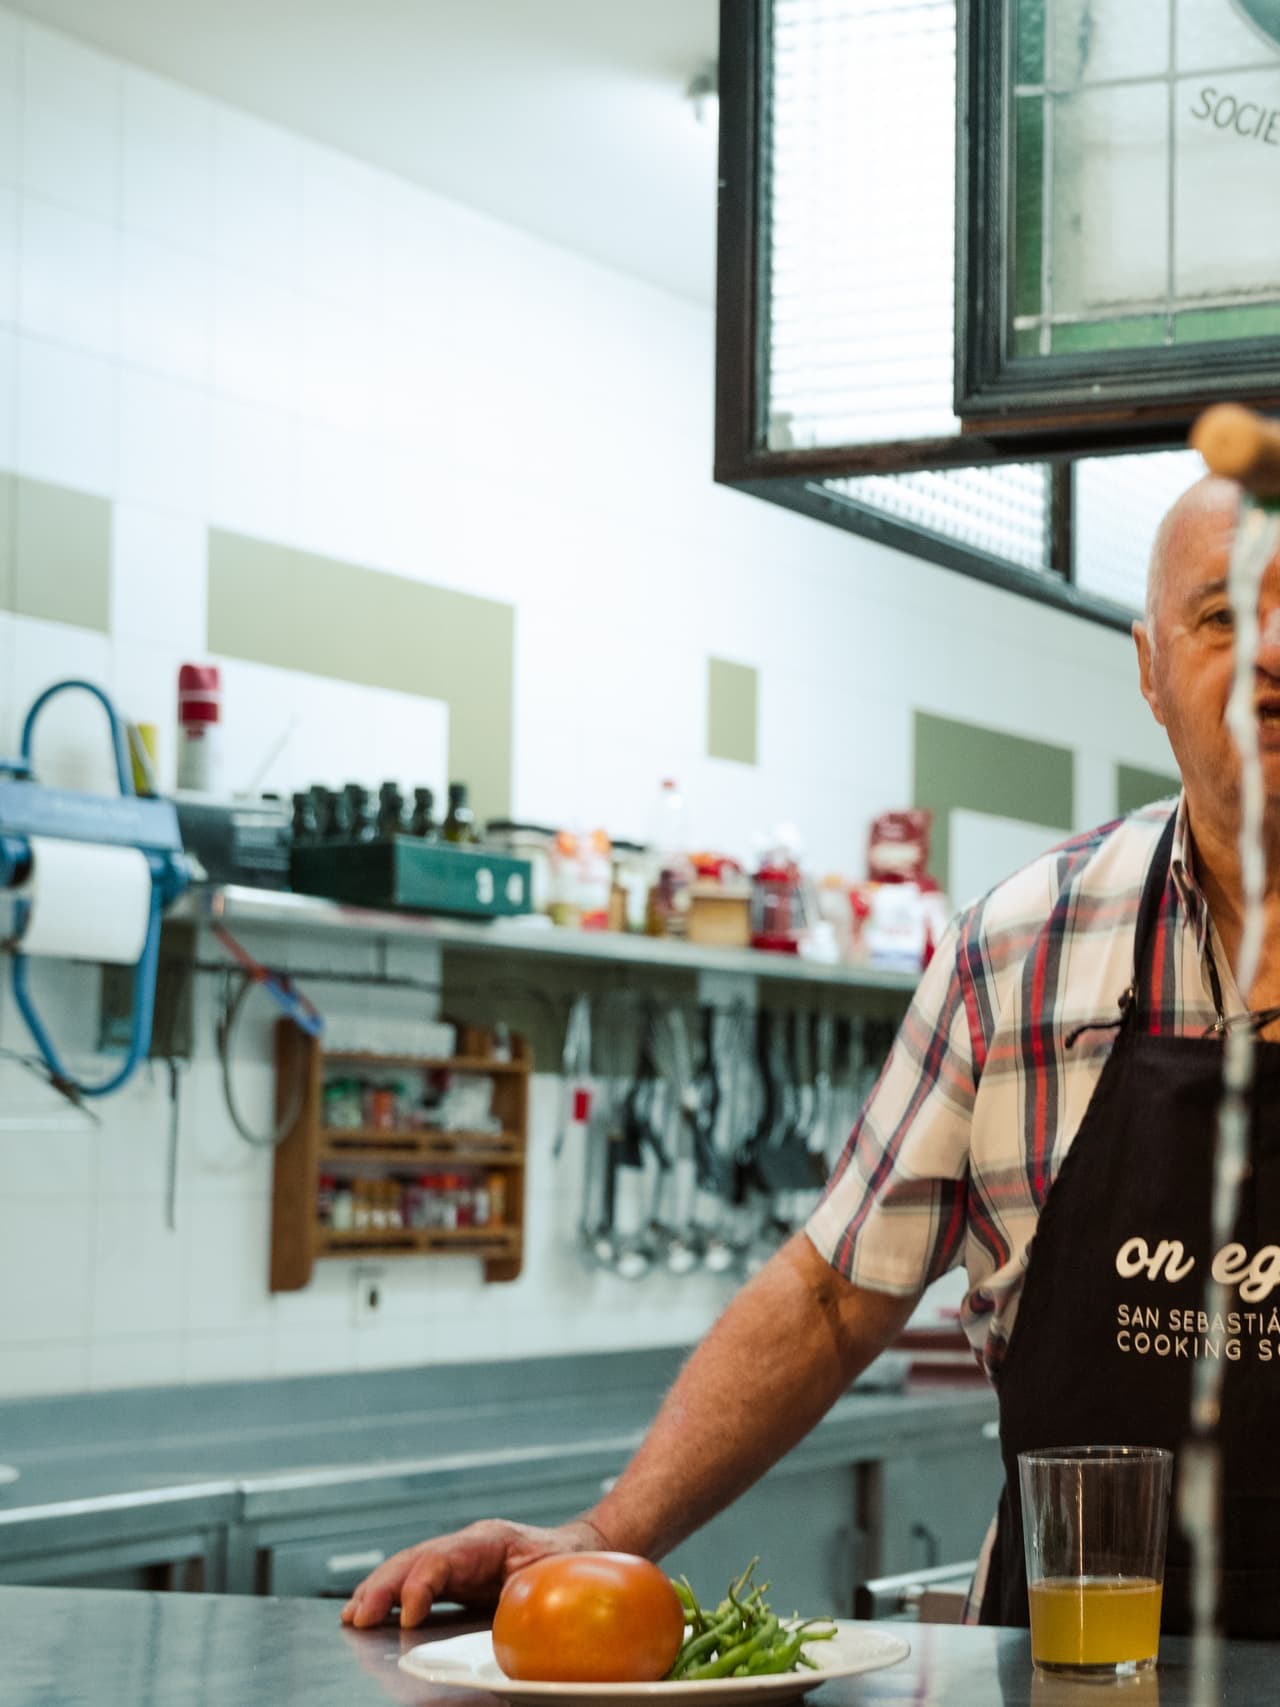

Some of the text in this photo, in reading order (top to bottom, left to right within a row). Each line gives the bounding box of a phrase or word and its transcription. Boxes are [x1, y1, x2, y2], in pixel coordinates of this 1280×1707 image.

[1115, 1236, 1195, 1283] on
[1117, 1304, 1159, 1329] SAN
[1117, 1330, 1241, 1361] COOKING
